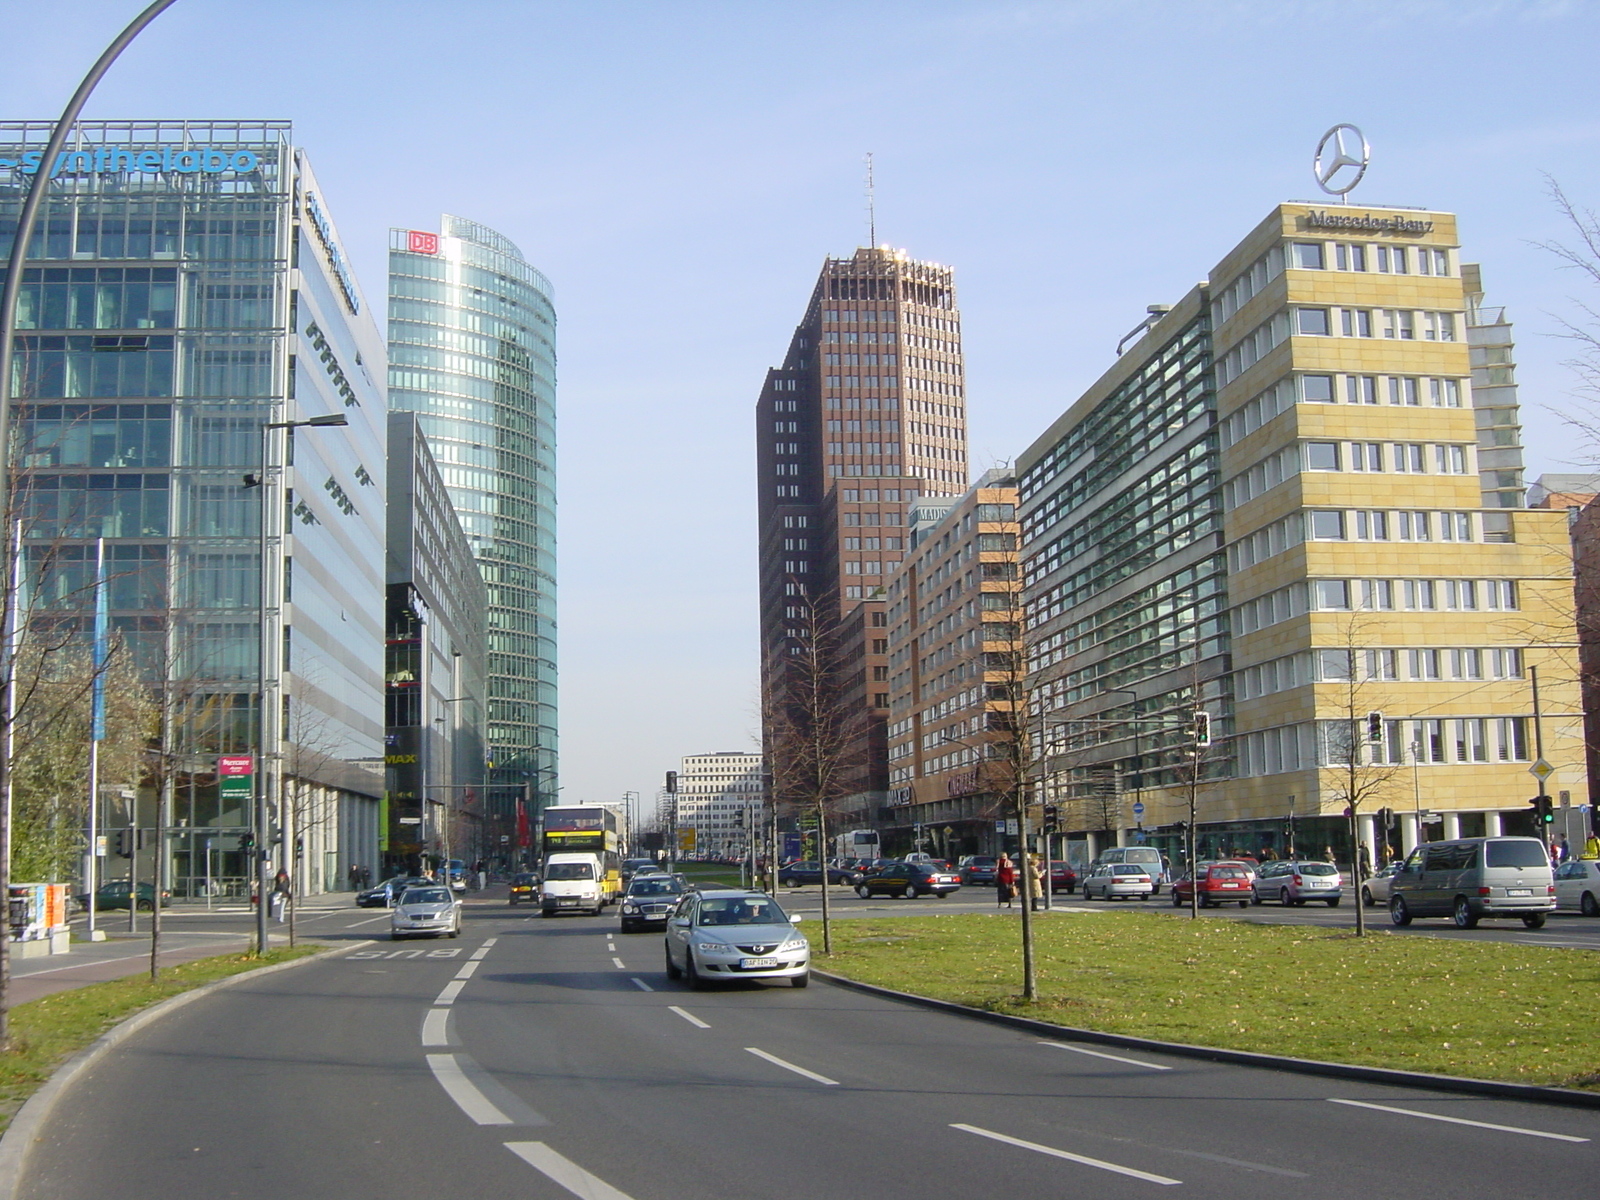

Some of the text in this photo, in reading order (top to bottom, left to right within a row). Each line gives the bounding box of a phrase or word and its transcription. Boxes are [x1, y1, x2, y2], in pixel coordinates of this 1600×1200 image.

[1308, 210, 1434, 234] Mercedes-Benz
[412, 234, 435, 250] DB
[345, 948, 463, 960] BUS
